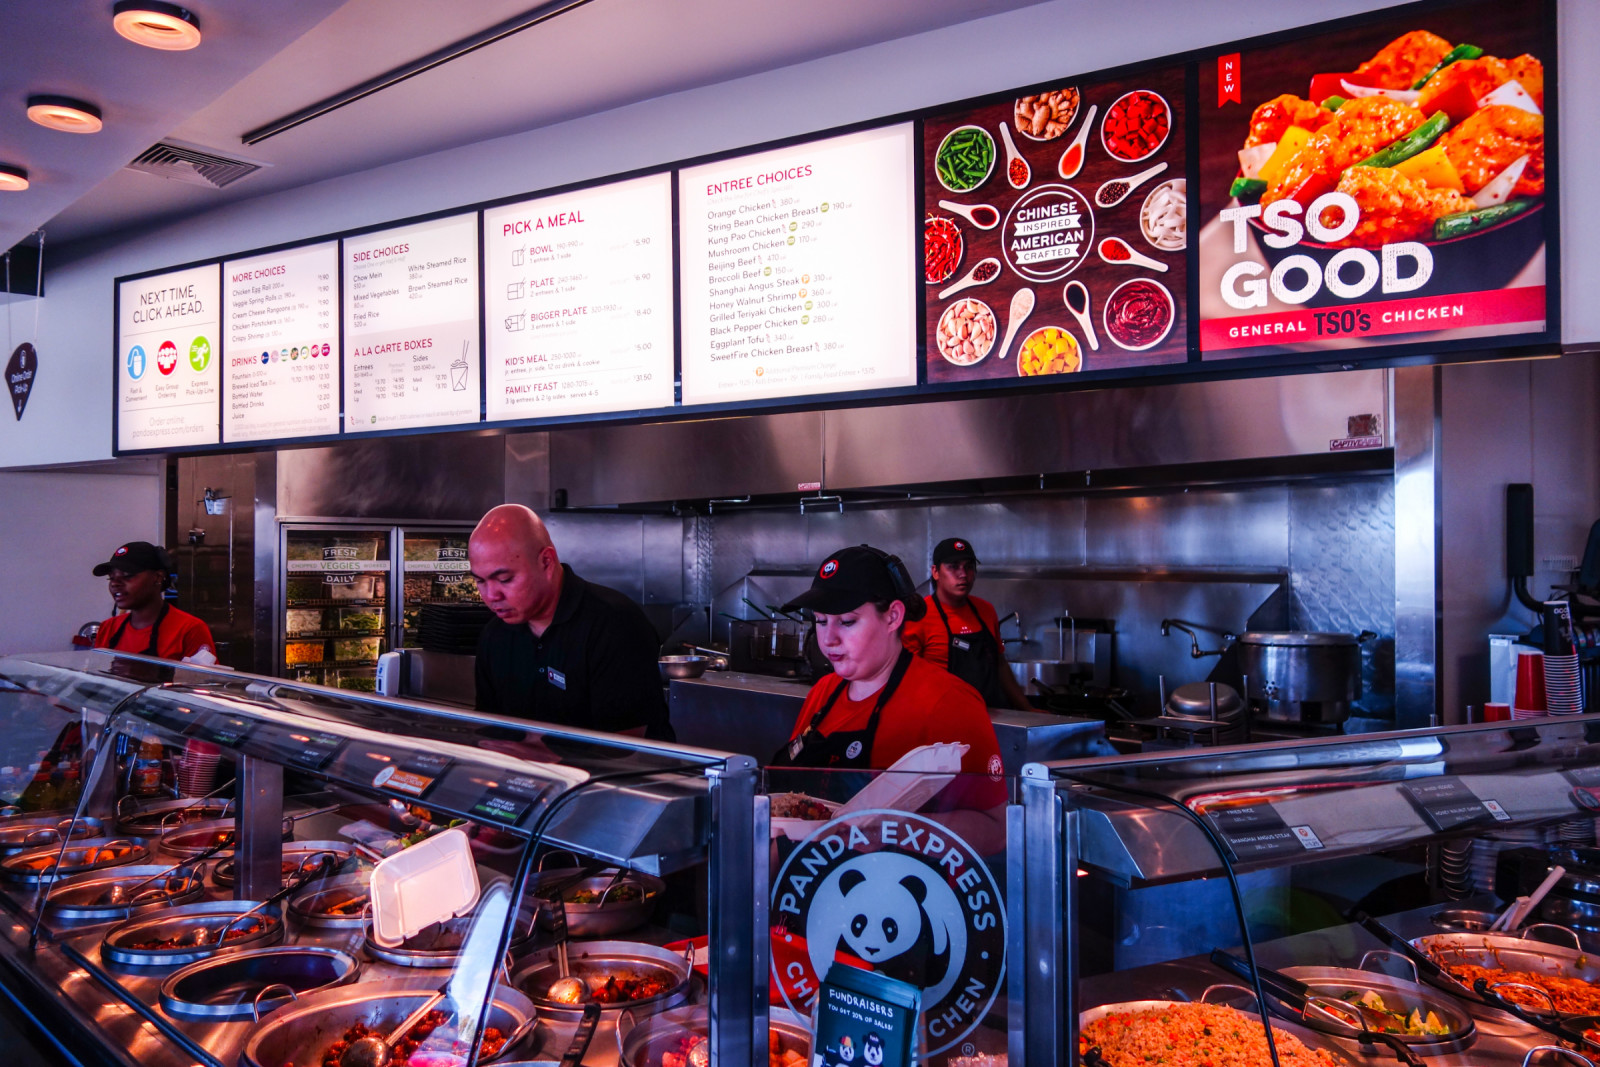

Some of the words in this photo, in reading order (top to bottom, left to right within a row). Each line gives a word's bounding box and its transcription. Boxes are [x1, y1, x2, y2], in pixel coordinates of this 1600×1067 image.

[1224, 62, 1234, 93] NEW
[707, 177, 753, 196] ENTREE
[757, 165, 812, 186] CHOICES
[708, 209, 736, 221] Orange
[739, 201, 771, 214] Chicken
[1017, 202, 1077, 221] CHINESE
[504, 219, 532, 237] PICK
[536, 218, 544, 231] A
[548, 210, 584, 227] MEAL
[708, 221, 731, 233] String
[734, 218, 754, 227] Bean
[756, 211, 789, 224] Chicken
[792, 206, 818, 217] Breast
[1023, 218, 1071, 232] INSPIRED
[1220, 192, 1360, 254] TSO
[708, 234, 728, 246] Kung
[730, 233, 746, 241] Pao
[748, 226, 781, 238] Chicken
[1011, 230, 1084, 251] AMERICAN
[353, 251, 371, 262] SIDE
[373, 243, 409, 259] CHOICES
[530, 244, 553, 256] BOWL
[708, 246, 750, 258] Mushroom
[752, 240, 785, 251] Chicken
[1024, 248, 1070, 261] CRAFTED
[427, 260, 452, 269] Steamed
[453, 257, 466, 265] Rice
[709, 262, 735, 272] Beijing
[737, 257, 756, 267] Beef
[232, 272, 252, 283] MORE
[255, 265, 286, 279] CHOICES
[353, 274, 367, 282] Chow
[709, 273, 740, 284] Broccoli
[743, 269, 761, 279] Beef
[1220, 241, 1434, 309] GOOD
[408, 285, 426, 293] Brown
[427, 281, 452, 289] Steamed
[454, 277, 468, 285] Rice
[530, 277, 555, 288] PLATE
[709, 286, 746, 297] Shanghai
[748, 282, 774, 292] Angus
[777, 278, 800, 287] Steak
[140, 289, 167, 306] NEXT
[169, 284, 197, 301] TIME,
[353, 293, 369, 301] Mixed
[371, 289, 399, 299] Vegetables
[535, 288, 554, 297] entrees
[565, 285, 576, 293] side
[233, 300, 248, 308] Veggie
[710, 301, 734, 311] Honey
[736, 296, 765, 306] Walnut
[767, 292, 797, 302] Shrimp
[811, 288, 825, 297] 360
[133, 307, 163, 323] CLICK
[165, 301, 205, 318] AHEAD.
[267, 306, 290, 315] Rangoons
[531, 310, 560, 322] BIGGER
[562, 306, 588, 317] PLATE
[710, 313, 735, 323] Grilled
[738, 309, 766, 319] Teriyaki
[769, 304, 802, 314] Chicken
[817, 301, 830, 309] 300
[232, 323, 250, 331] Chicken
[536, 322, 554, 330] entrees
[710, 327, 731, 336] Black
[734, 322, 762, 333] Pepper
[764, 318, 798, 329] Chicken
[813, 315, 826, 323] 280
[1229, 320, 1306, 338] GENERAL
[1313, 309, 1371, 336] TSO's
[1382, 305, 1464, 323] CHICKEN
[248, 332, 264, 340] Shrimp
[711, 339, 745, 350] Eggplant
[748, 335, 765, 344] Tofu
[774, 334, 787, 342] 340
[354, 349, 359, 357] A
[362, 347, 371, 356] LA
[374, 342, 401, 355] CARTE
[404, 339, 432, 351] BOXES
[710, 351, 748, 362] SweetFire
[751, 347, 783, 358] Chicken
[786, 344, 813, 354] Breast
[823, 342, 837, 350] 380
[232, 356, 257, 367] DRINKS
[354, 364, 373, 372] Entrees
[505, 358, 524, 366] KID'S
[527, 354, 548, 364] MEAL
[505, 385, 531, 395] FAMILY
[534, 382, 558, 392] FEAST
[516, 396, 534, 404] entrees
[150, 417, 165, 426] Order
[166, 416, 184, 424] online
[779, 825, 869, 915] PANDA
[881, 821, 996, 932] EXPRESS
[828, 1003, 839, 1011] YOU
[840, 1007, 851, 1016] GET
[829, 989, 893, 1018] FUNDRAISERS
